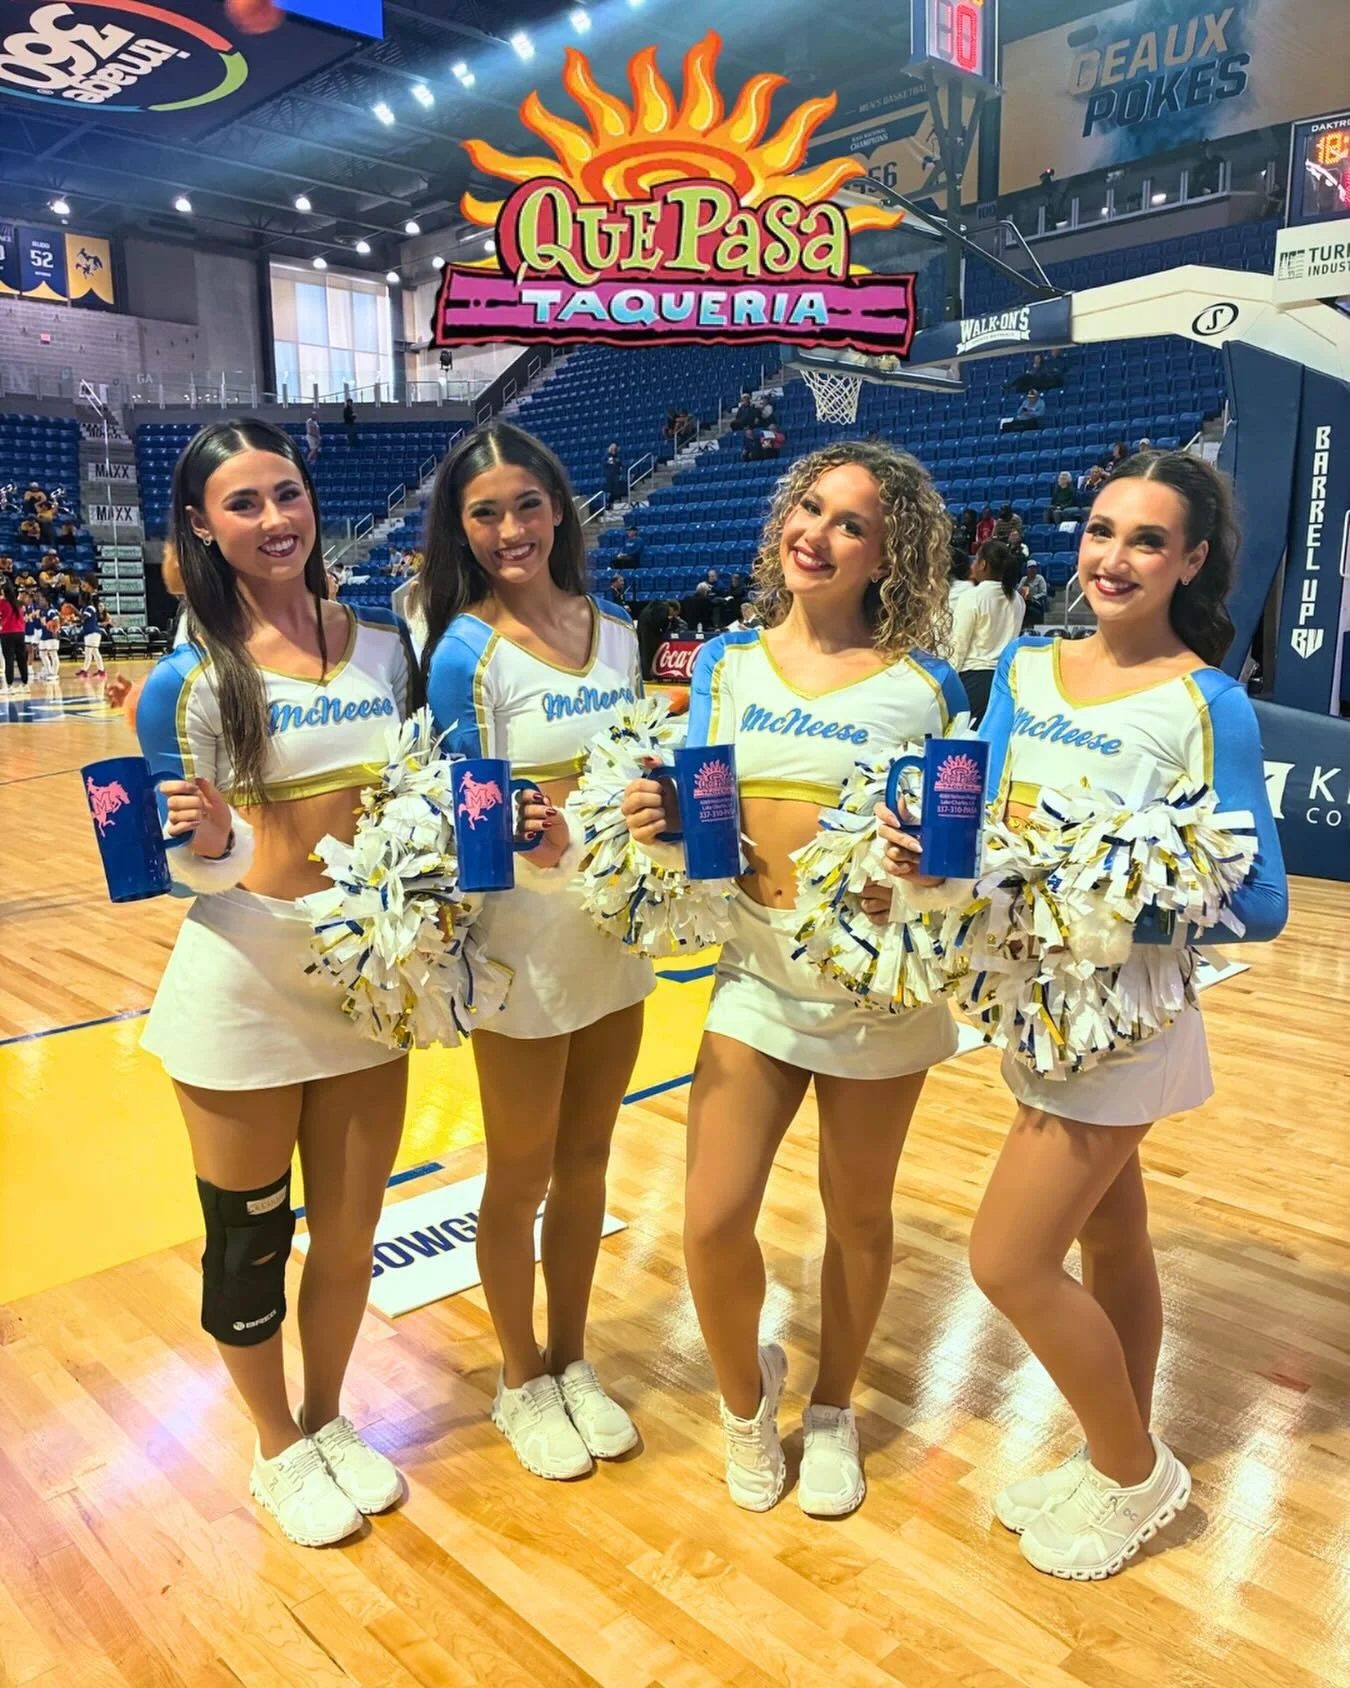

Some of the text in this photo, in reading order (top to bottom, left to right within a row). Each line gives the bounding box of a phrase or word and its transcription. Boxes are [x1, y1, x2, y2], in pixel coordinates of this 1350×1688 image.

[0, 3, 135, 89] 360
[62, 38, 191, 104] image
[1067, 8, 1234, 95] GEAUX
[1082, 52, 1251, 138] POKES
[30, 249, 54, 268] 52
[1306, 425, 1332, 571] BARREL
[1299, 579, 1318, 625] UP
[269, 695, 394, 736] McNeese
[740, 703, 869, 745] McNeese
[1012, 707, 1122, 755] McNeese
[1309, 765, 1350, 804] K
[371, 1209, 480, 1278] OWG
